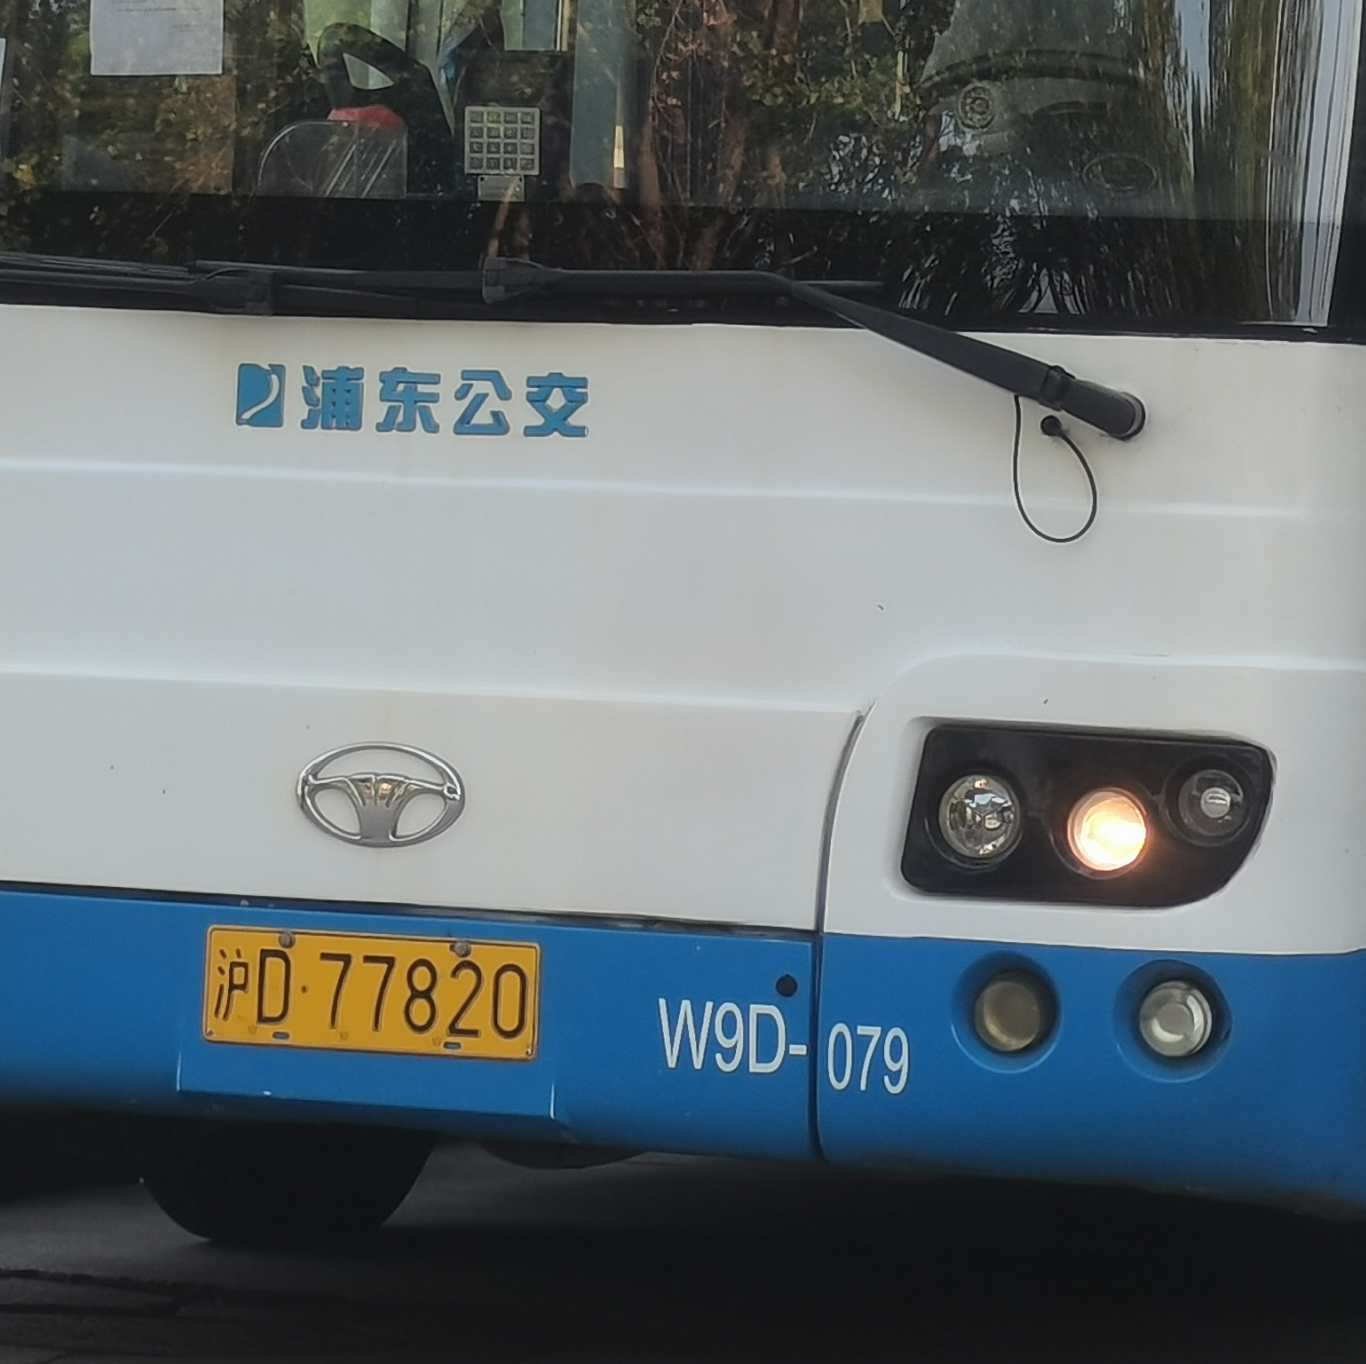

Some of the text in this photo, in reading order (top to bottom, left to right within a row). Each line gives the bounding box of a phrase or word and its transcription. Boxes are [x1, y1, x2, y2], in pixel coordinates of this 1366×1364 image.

[300, 355, 589, 438] 浦东公交
[658, 997, 909, 1094] W9D-079
